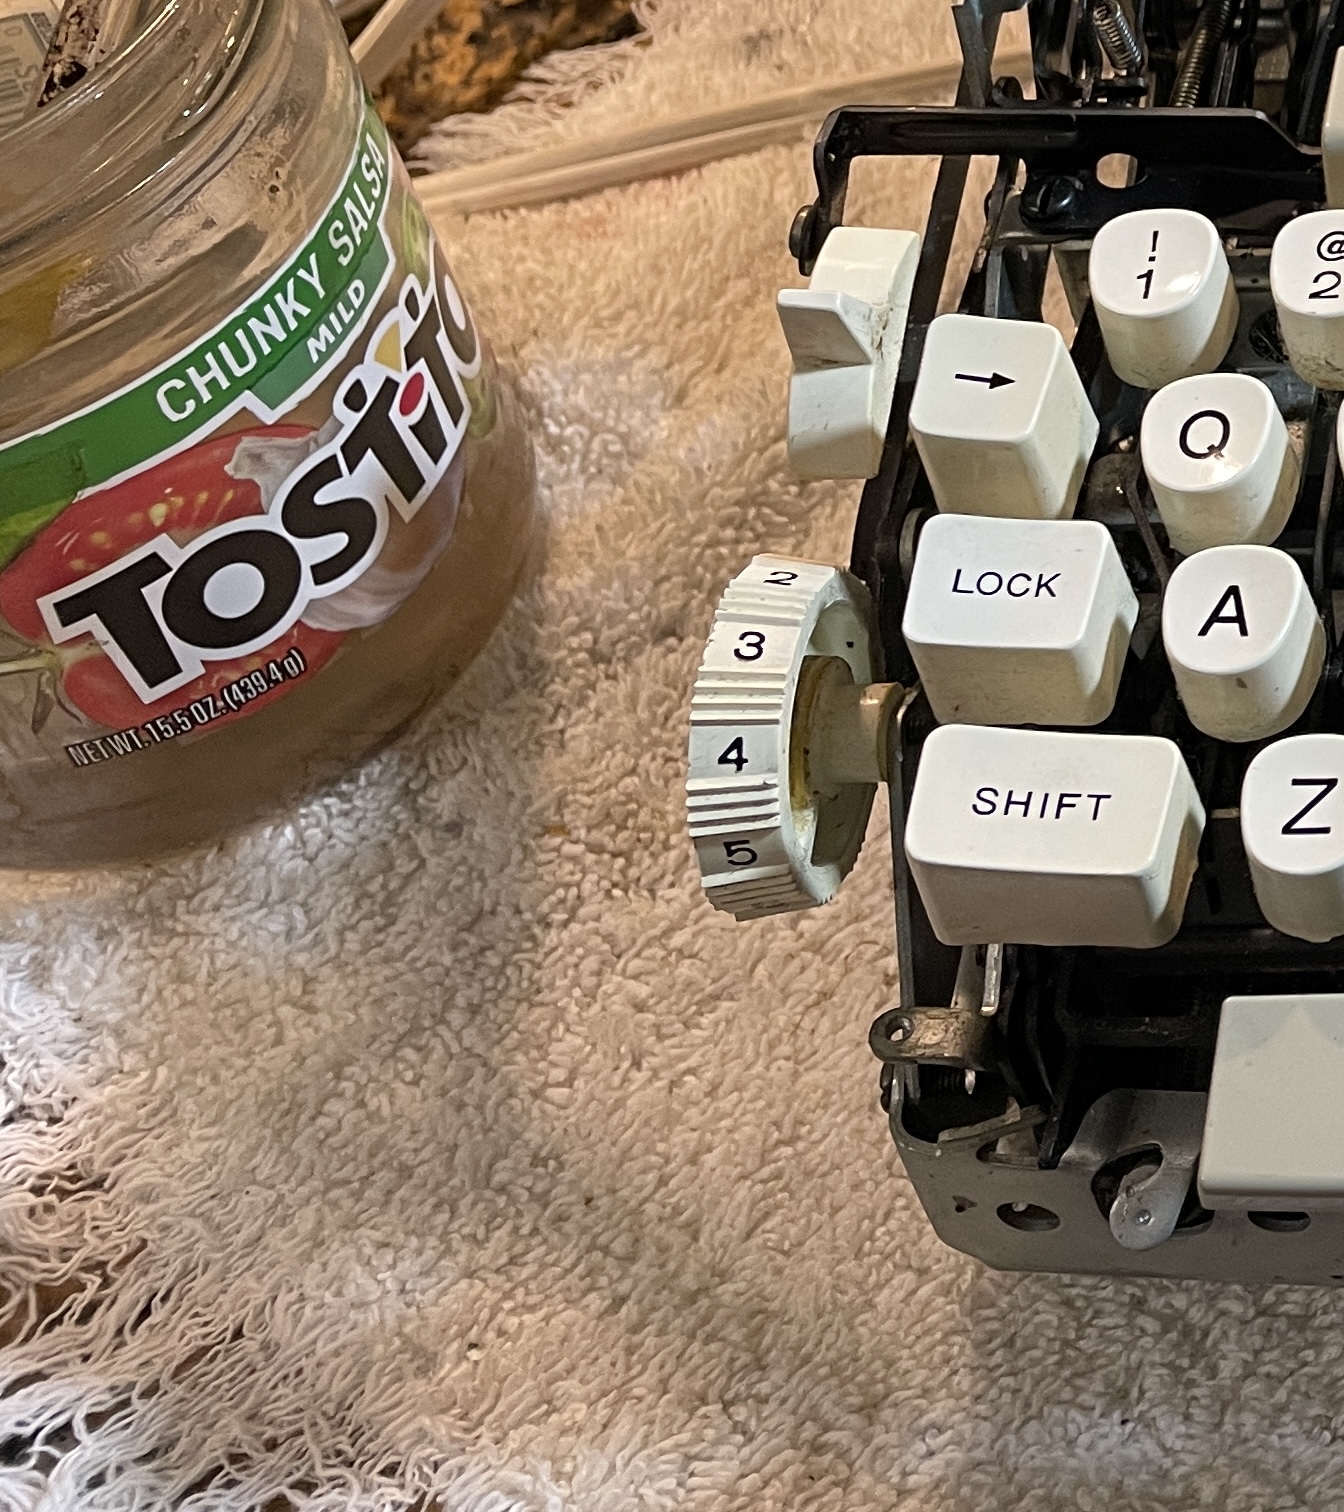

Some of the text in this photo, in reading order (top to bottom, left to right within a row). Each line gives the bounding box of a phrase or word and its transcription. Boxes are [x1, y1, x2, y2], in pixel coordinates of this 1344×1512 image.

[1148, 230, 1159, 262] !
[156, 132, 385, 422] CHUNKY SALSA
[1136, 268, 1154, 300] 1
[1308, 270, 1342, 300] 2
[306, 279, 365, 364] MILD
[1178, 409, 1231, 460] Q
[763, 571, 799, 586] 2
[951, 568, 1062, 598] LOCK
[1197, 584, 1249, 637] A
[733, 631, 766, 662] 3
[68, 740, 110, 767] NET
[145, 710, 192, 743] 15.5
[223, 664, 283, 711] (439.4
[283, 648, 306, 678] g)
[717, 736, 749, 774] 4
[971, 787, 1112, 821] SHIFT
[1280, 777, 1339, 836] Z
[722, 839, 758, 866] 5
